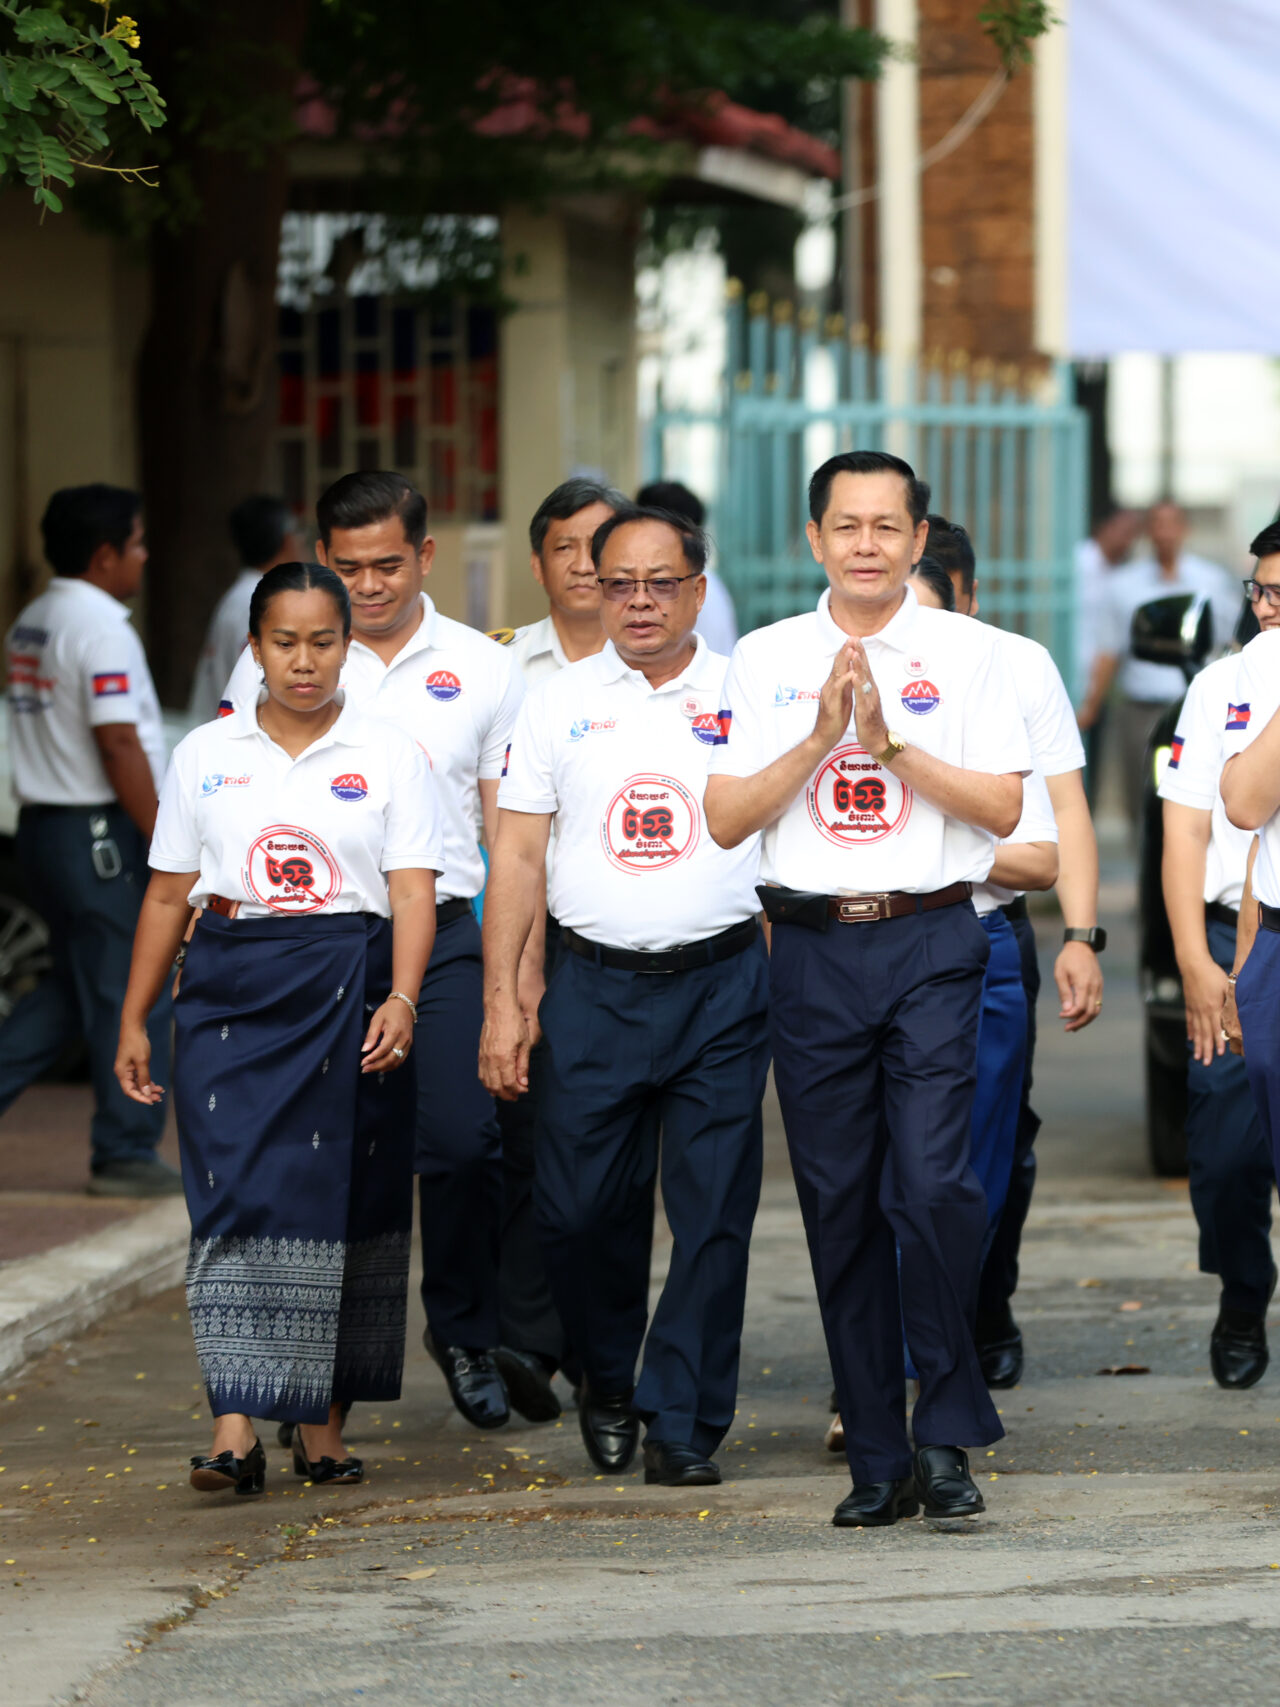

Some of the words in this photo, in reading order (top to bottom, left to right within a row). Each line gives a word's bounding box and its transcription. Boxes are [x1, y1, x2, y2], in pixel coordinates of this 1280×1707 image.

[629, 789, 669, 800] និយាយថា
[833, 776, 887, 813] ទេ
[848, 811, 876, 822] ចំពោះ
[622, 806, 674, 841] ទេ
[267, 840, 309, 852] និយាយថា
[635, 838, 663, 849] ចំពោះ
[265, 856, 315, 890] ទេ
